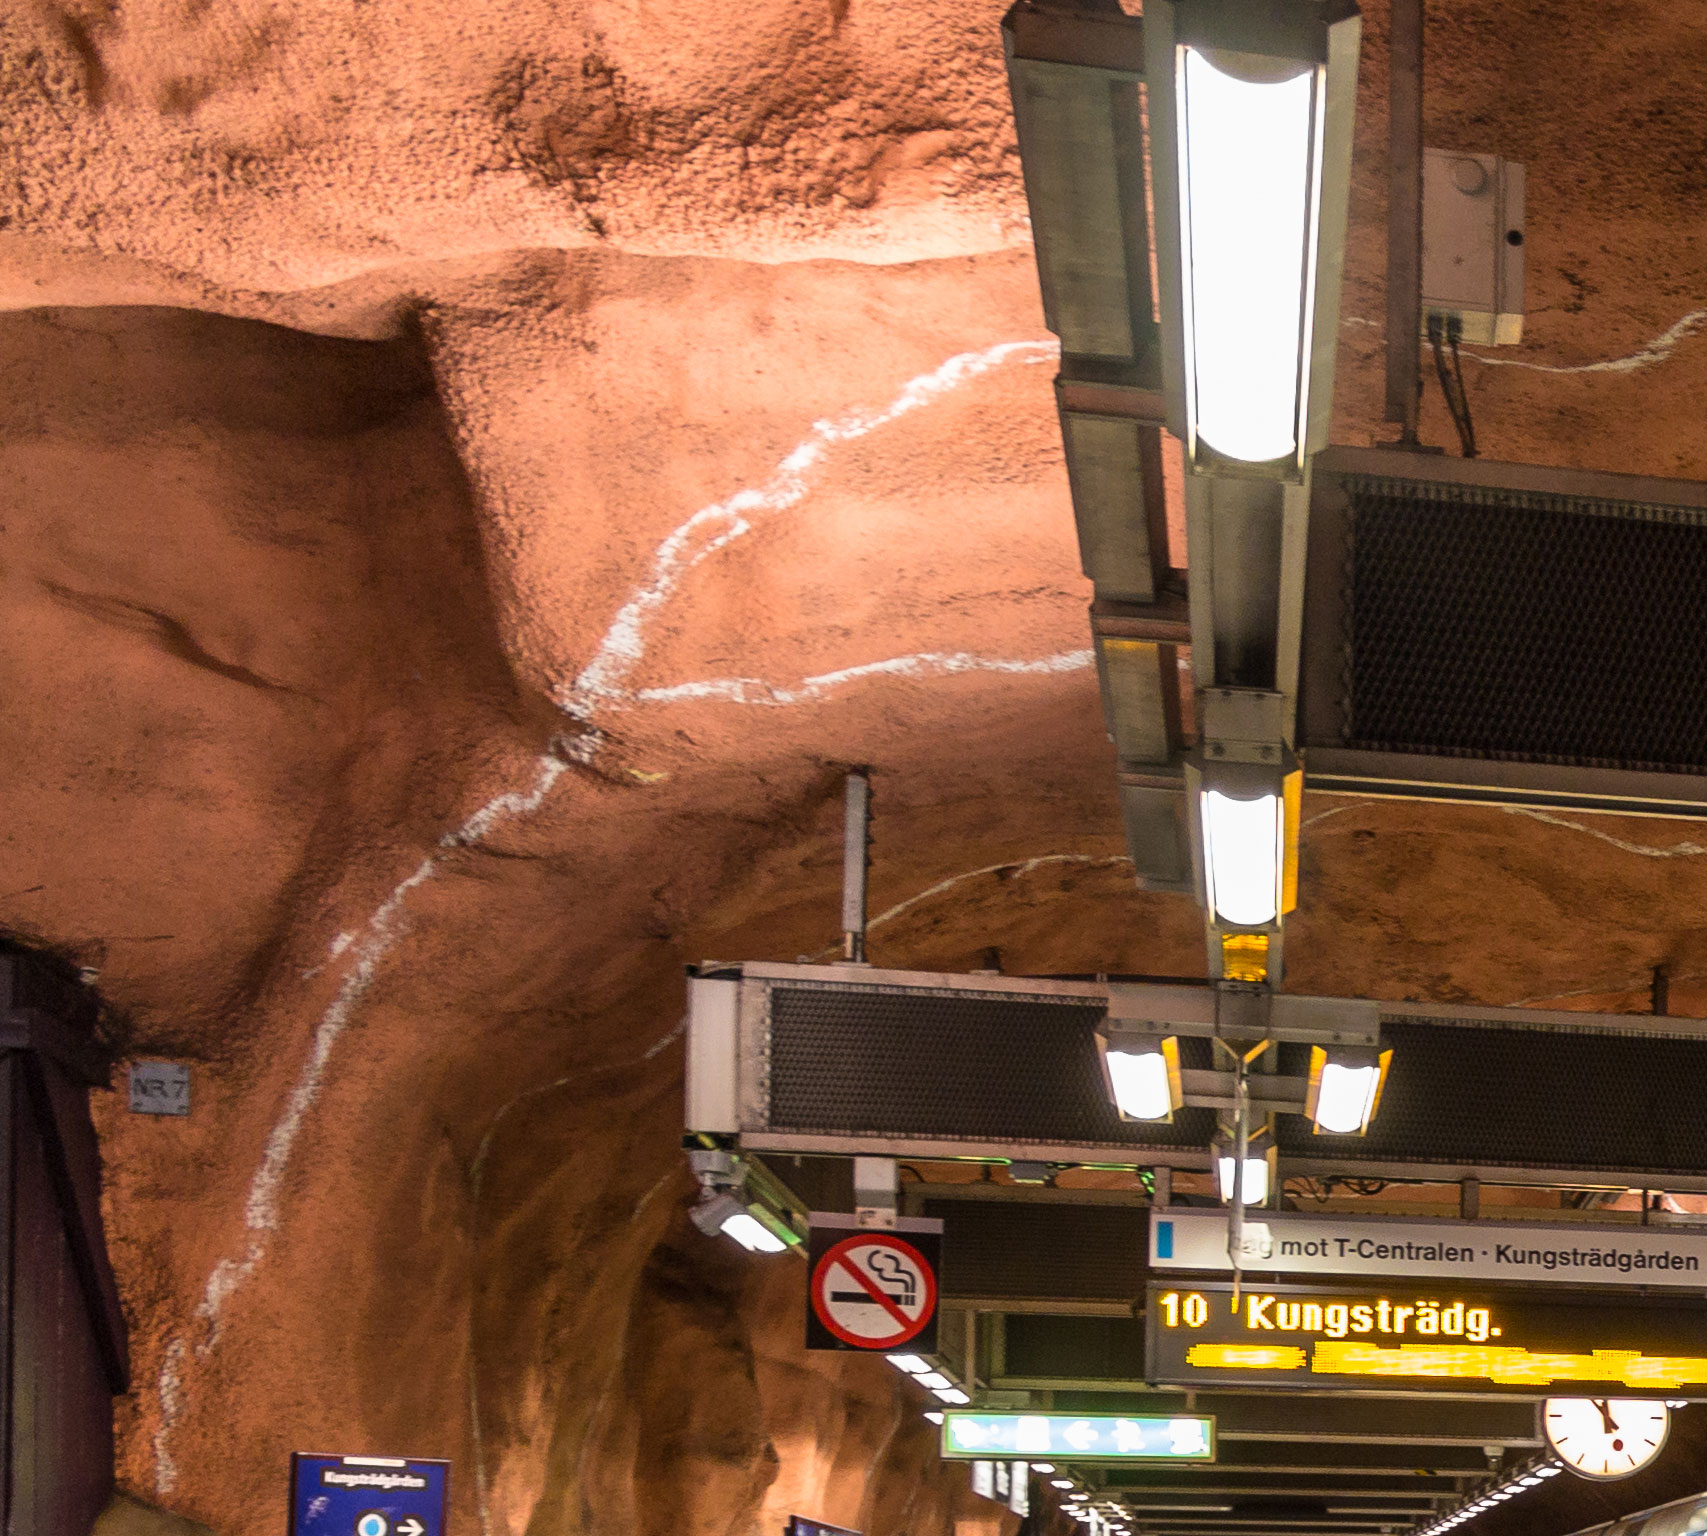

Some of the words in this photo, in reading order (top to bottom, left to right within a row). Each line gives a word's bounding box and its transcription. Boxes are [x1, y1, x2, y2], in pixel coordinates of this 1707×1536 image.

[1281, 1238, 1328, 1257] mot
[1334, 1238, 1475, 1263] T-Centralen
[1495, 1244, 1699, 1272] Kungsträdgården
[1160, 1292, 1208, 1328] 10
[1247, 1294, 1502, 1341] Kungsträdg.
